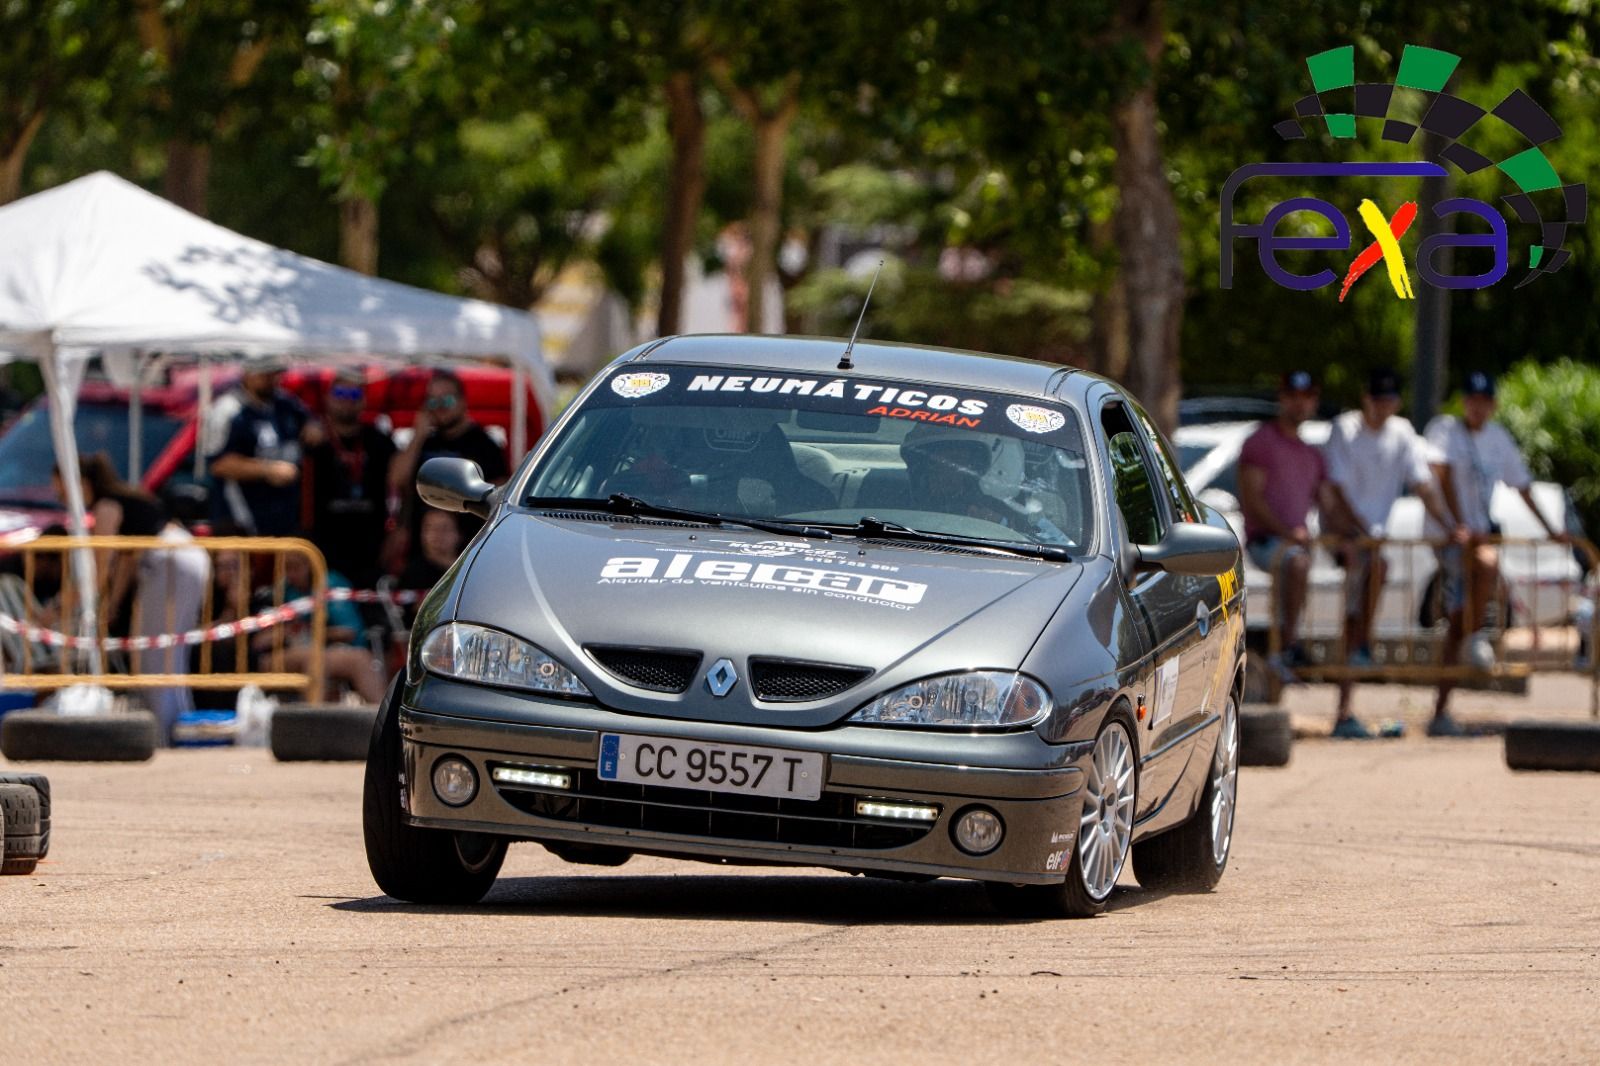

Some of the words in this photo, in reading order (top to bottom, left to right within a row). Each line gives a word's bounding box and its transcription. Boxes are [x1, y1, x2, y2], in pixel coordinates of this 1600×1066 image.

[687, 375, 988, 415] NEUMÁTICOS
[597, 577, 667, 585] Alquiler
[672, 577, 694, 585] de
[792, 587, 818, 595] sin
[824, 591, 915, 611] conductor
[600, 554, 928, 604] alecar
[604, 760, 613, 772] E
[635, 743, 677, 779] CC
[686, 748, 774, 788] 9557
[783, 757, 803, 792] T
